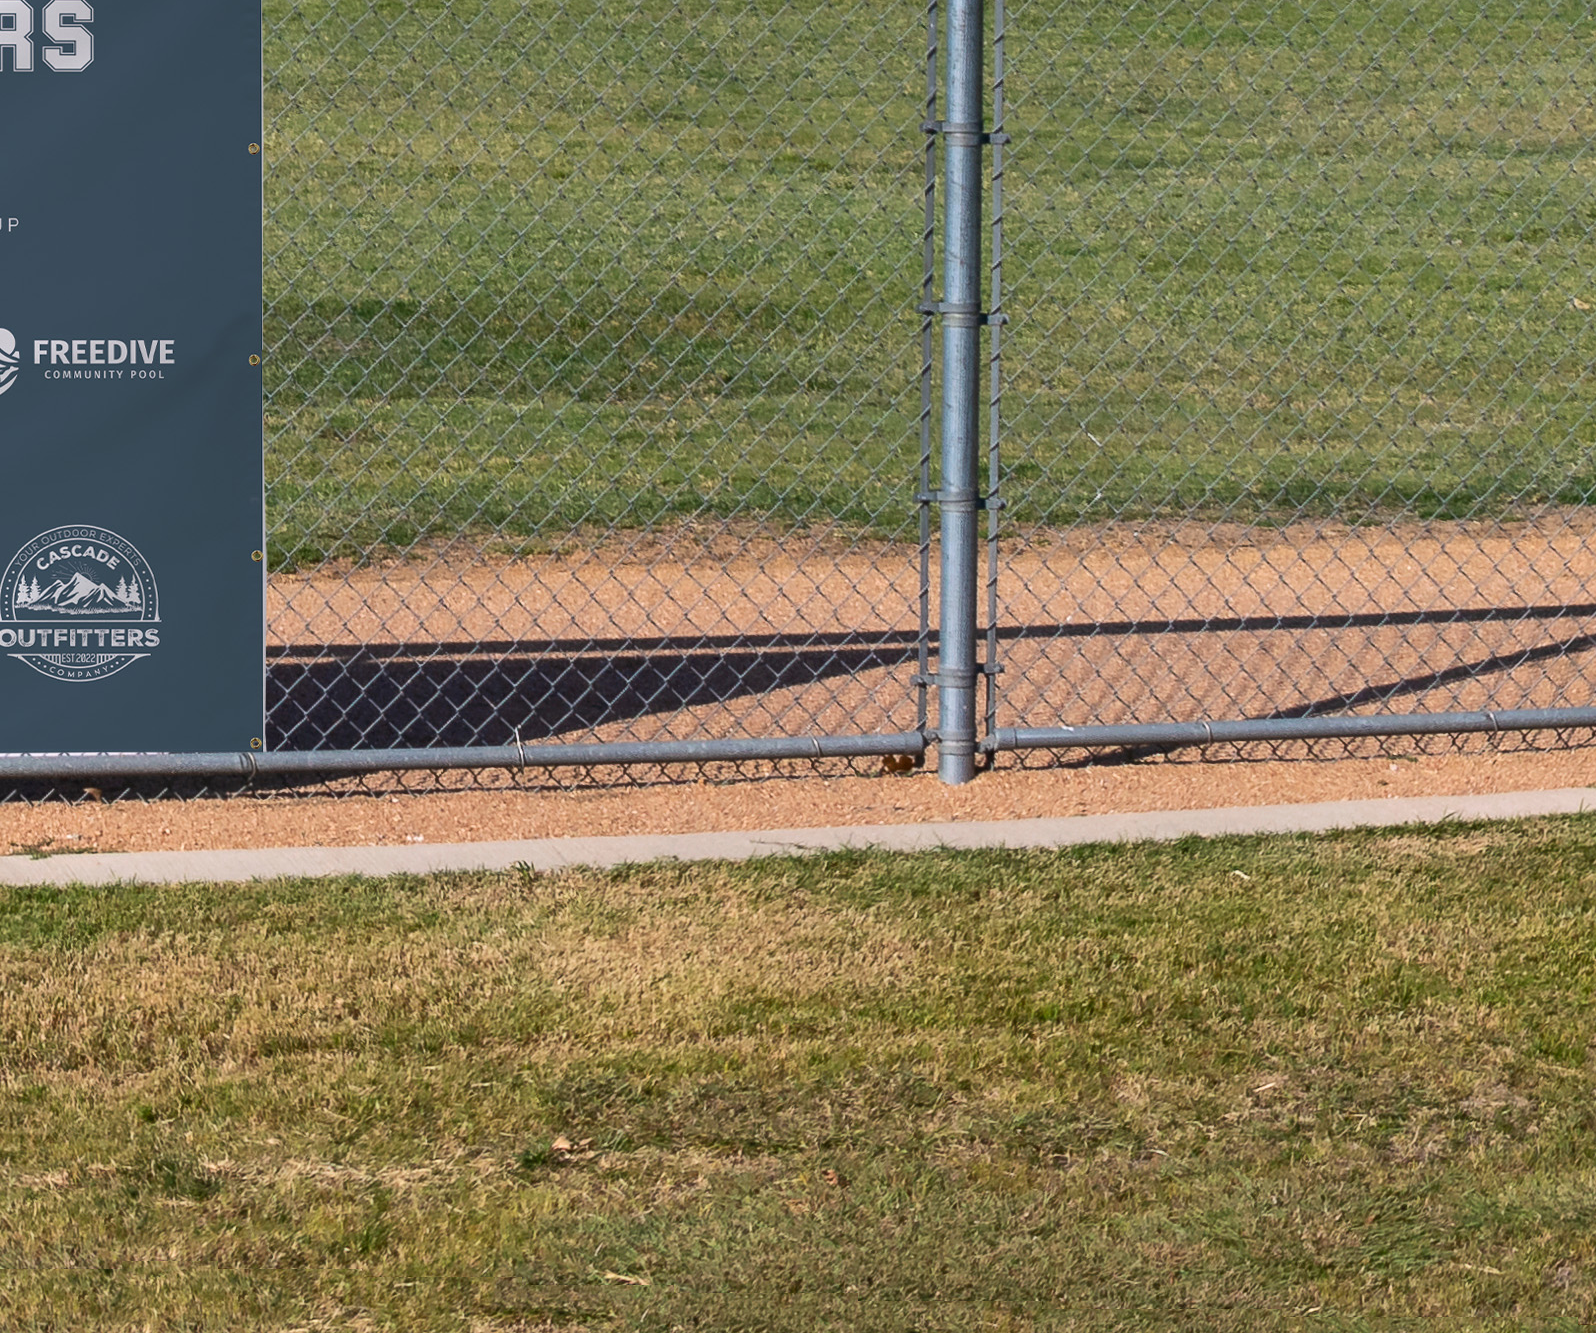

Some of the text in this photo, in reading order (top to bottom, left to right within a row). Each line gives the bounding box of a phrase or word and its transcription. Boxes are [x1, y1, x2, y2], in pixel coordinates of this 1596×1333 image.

[34, 340, 175, 364] FREEDIVE
[45, 370, 164, 379] COMMUNITY POOL
[14, 528, 142, 567] YOUR OUTDOOR EXPERTS
[36, 544, 121, 571] CASCADE
[49, 665, 109, 678] COMPANY
